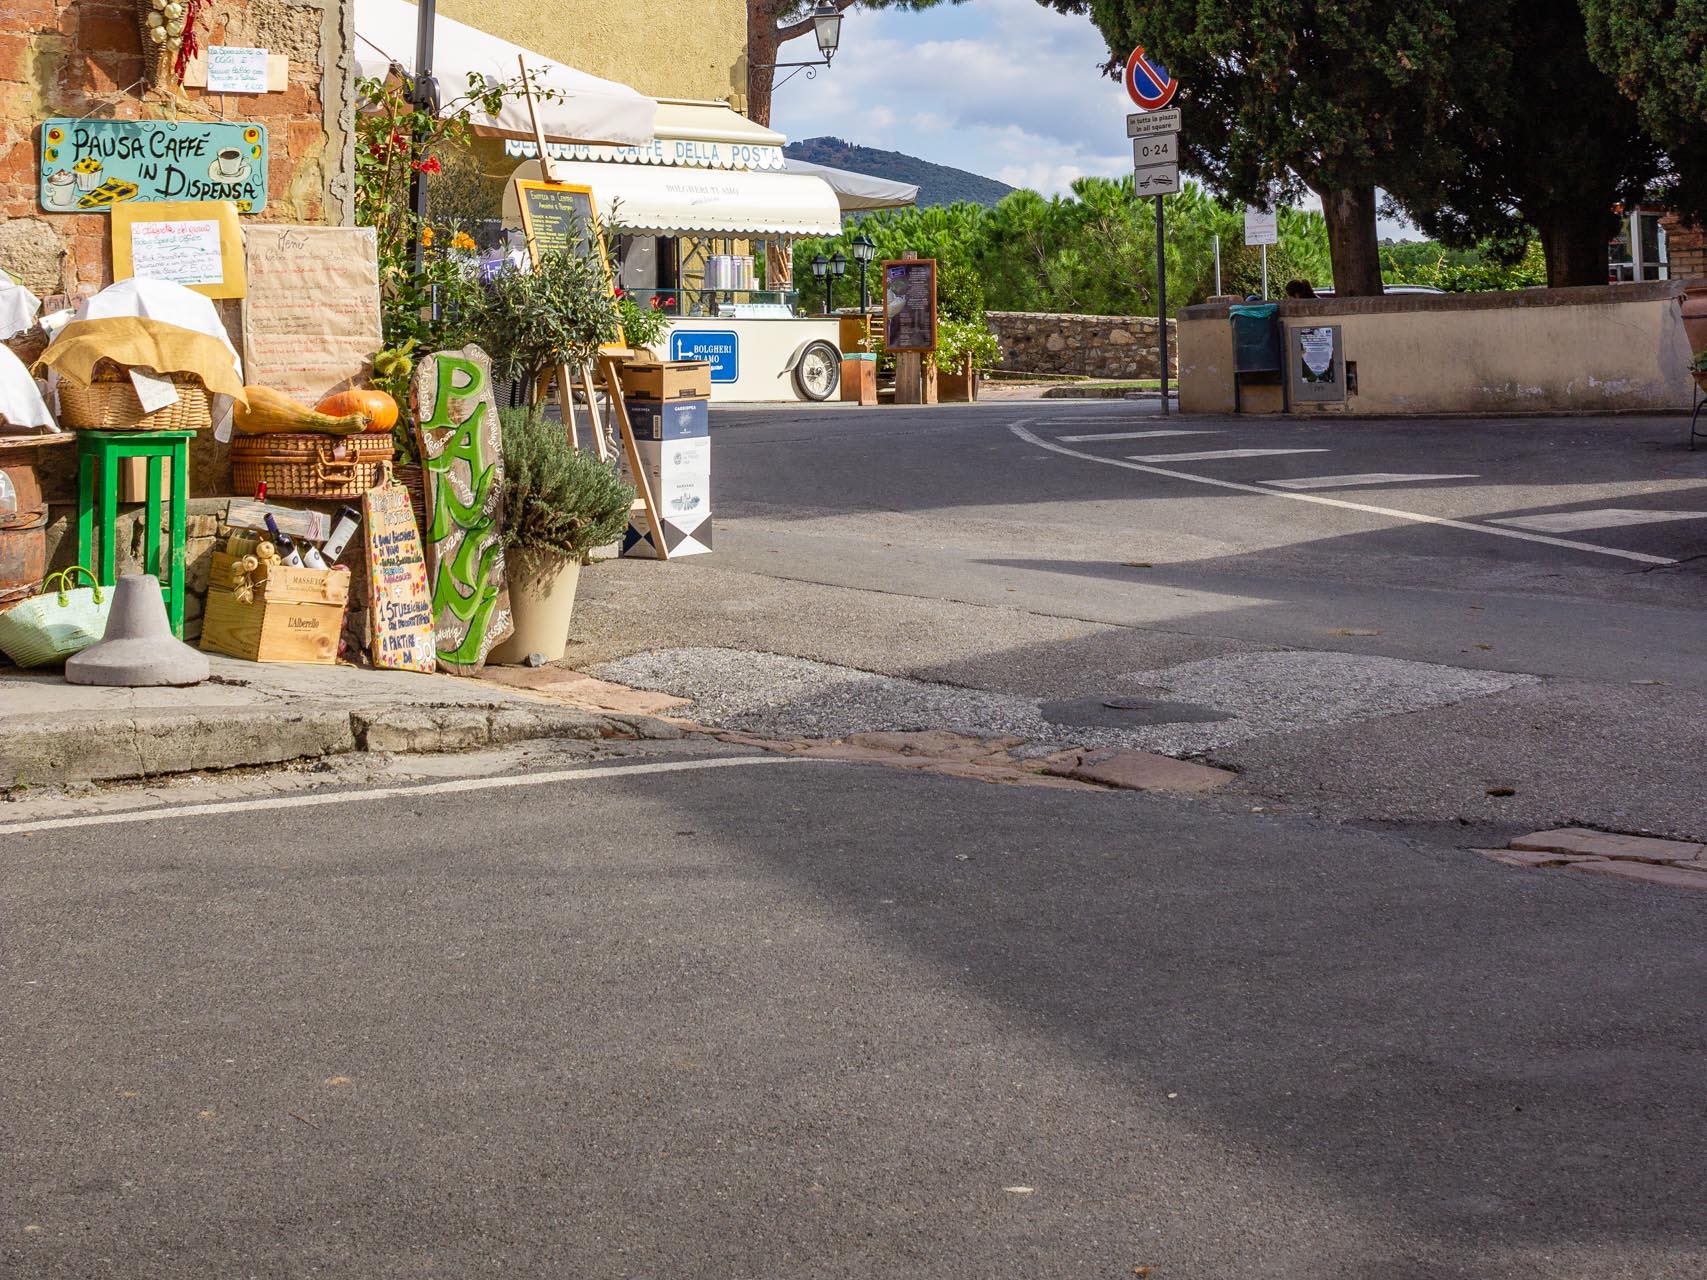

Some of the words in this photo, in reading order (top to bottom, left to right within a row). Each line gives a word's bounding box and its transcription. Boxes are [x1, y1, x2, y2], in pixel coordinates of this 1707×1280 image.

[1159, 114, 1177, 122] piazza
[1152, 123, 1172, 131] square
[72, 128, 145, 162] PAUSA
[1142, 144, 1168, 157] 0-24
[675, 141, 720, 161] DELLA
[732, 145, 779, 163] POSTA
[155, 164, 258, 201] DISPENSA
[693, 344, 732, 354] BOLGHERI
